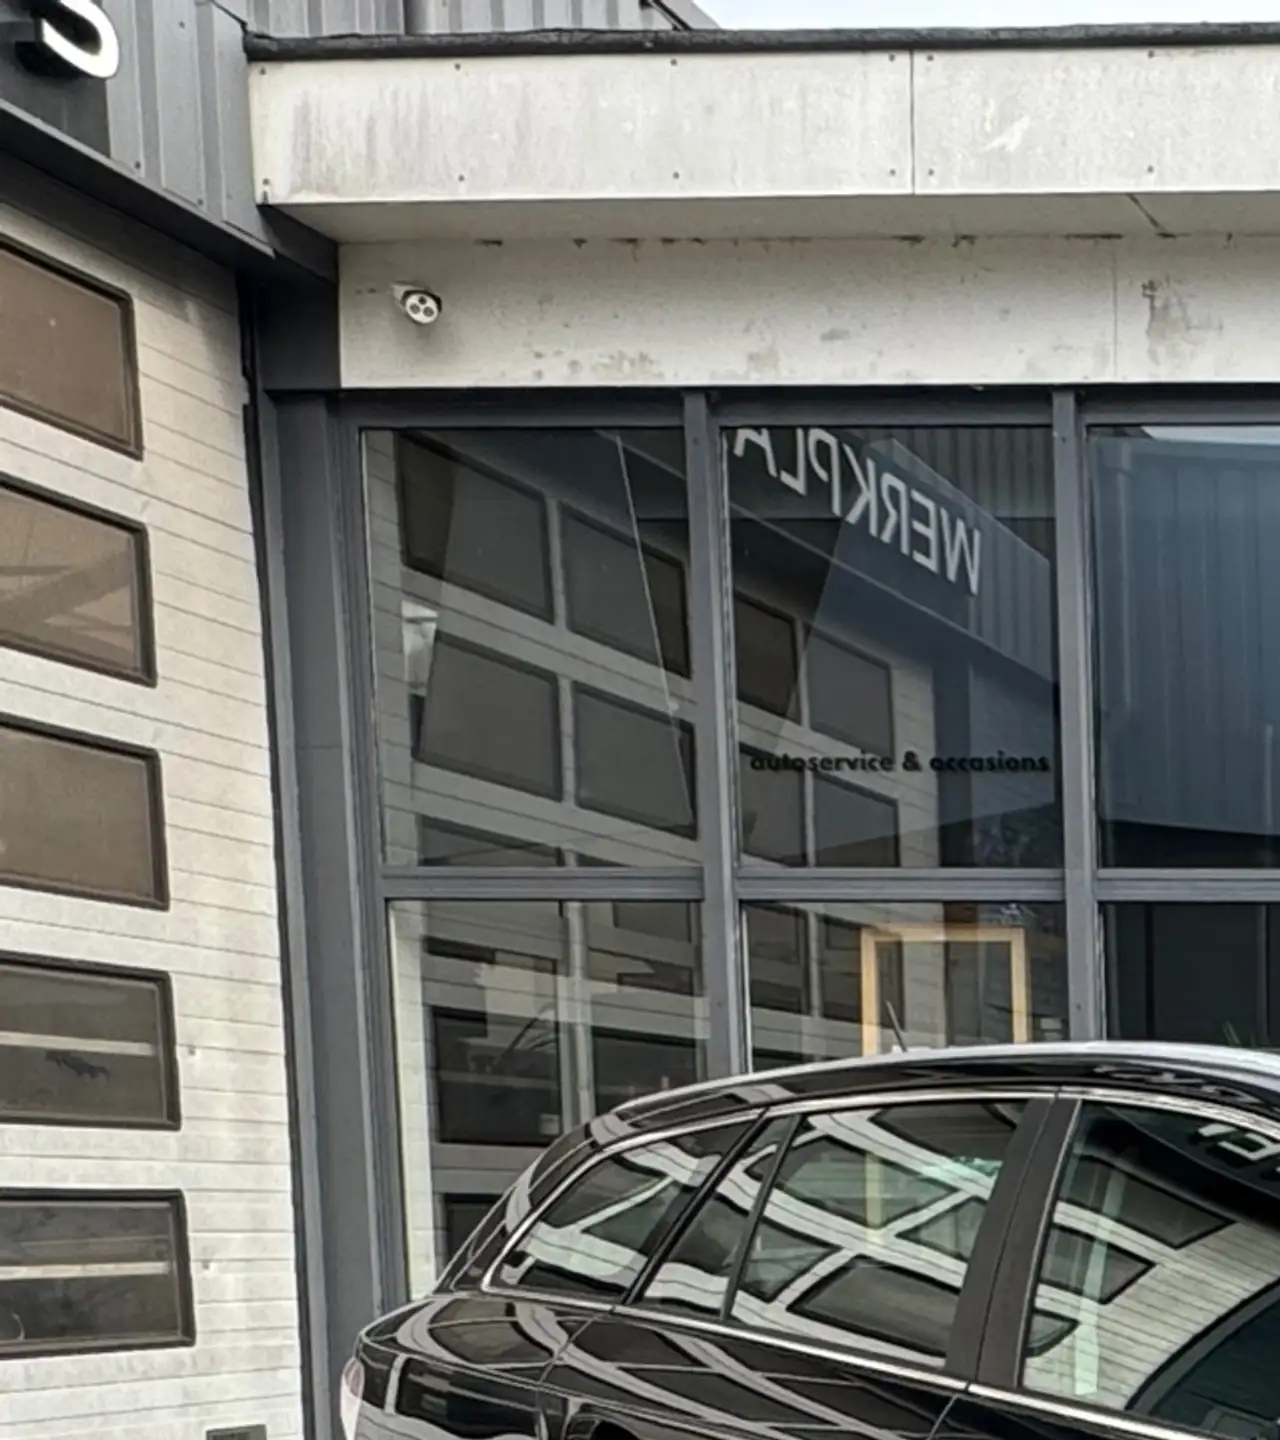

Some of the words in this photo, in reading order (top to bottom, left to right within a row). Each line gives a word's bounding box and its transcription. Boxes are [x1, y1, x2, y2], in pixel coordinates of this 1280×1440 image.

[750, 751, 894, 773] autoservice
[902, 751, 922, 772] &
[929, 750, 1050, 773] occasions
